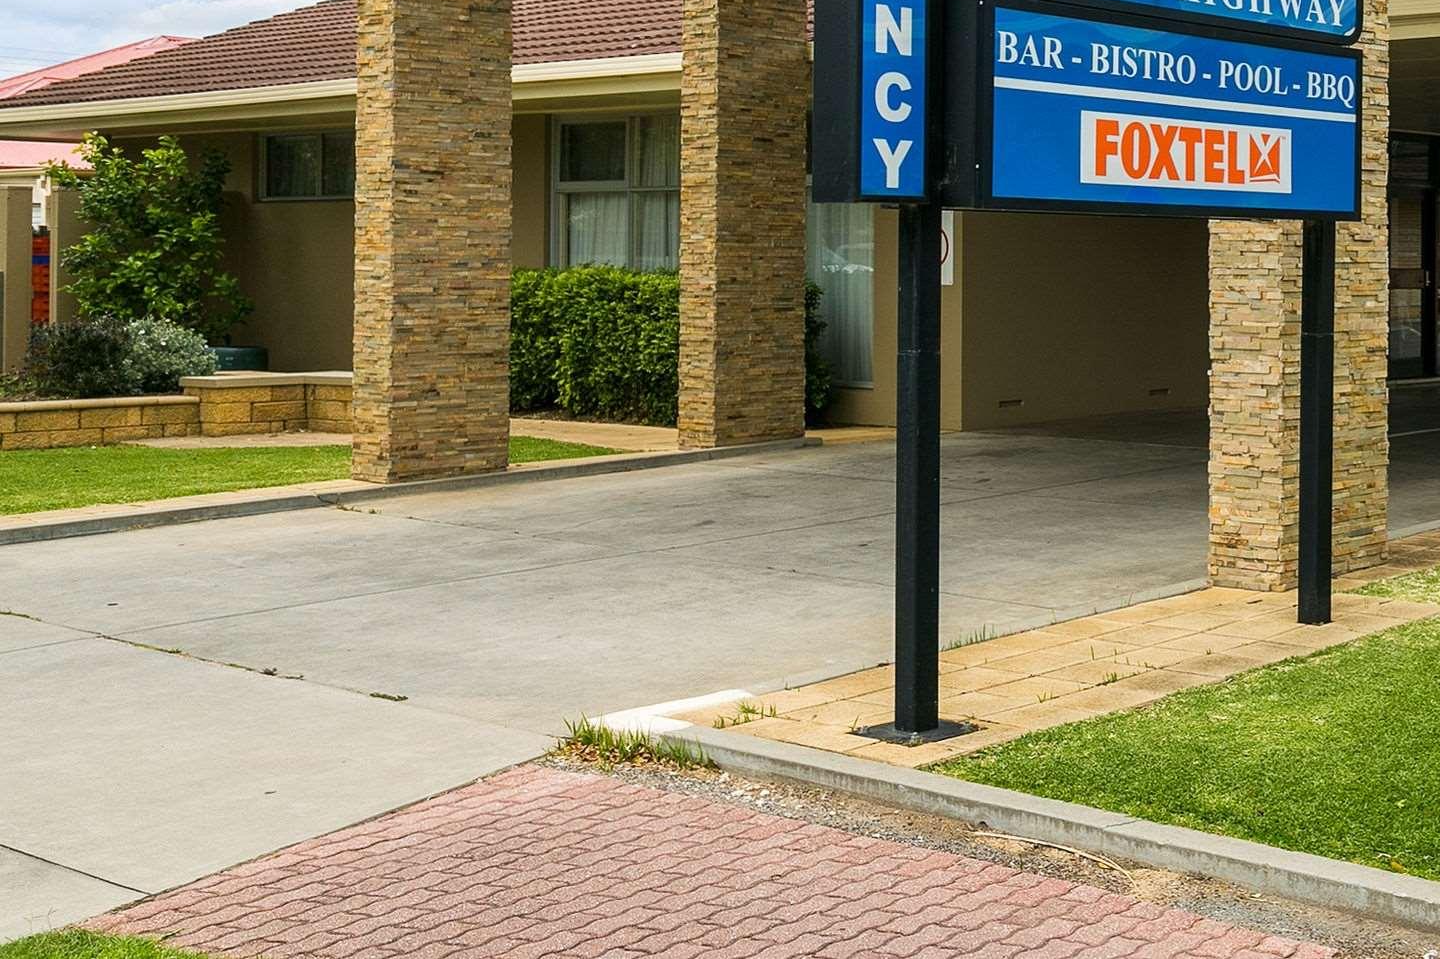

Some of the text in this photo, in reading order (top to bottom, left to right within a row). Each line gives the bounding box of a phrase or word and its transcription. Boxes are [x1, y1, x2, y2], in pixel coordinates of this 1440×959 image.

[997, 30, 1064, 69] BAR
[1089, 42, 1196, 85] BISTRO
[1217, 59, 1288, 95] POOL
[1306, 71, 1355, 108] BBQ
[1095, 118, 1245, 184] FOXTEL
